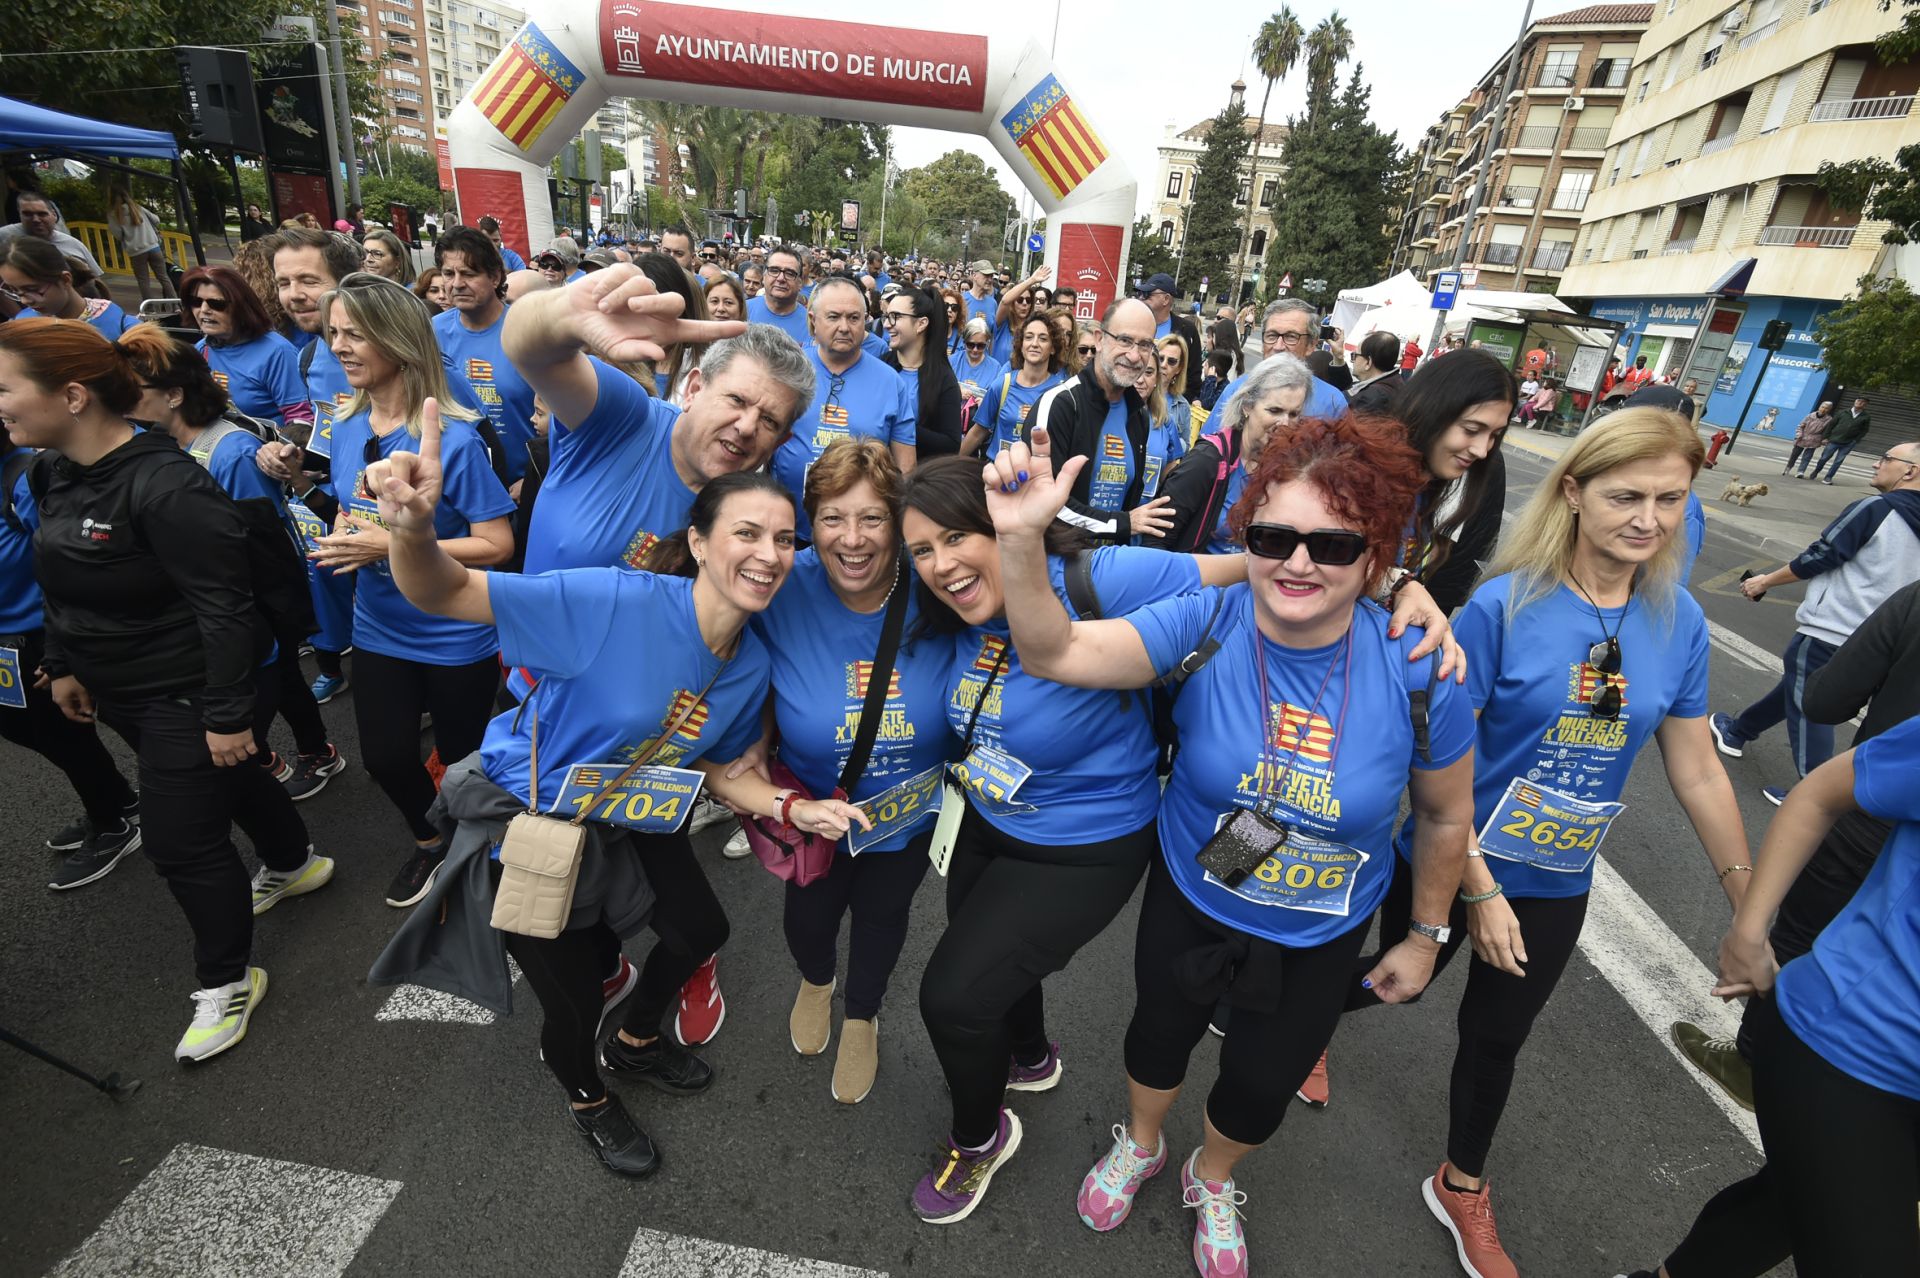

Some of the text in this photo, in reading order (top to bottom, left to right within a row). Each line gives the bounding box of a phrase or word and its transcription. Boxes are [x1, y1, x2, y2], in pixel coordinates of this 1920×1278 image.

[655, 34, 972, 86] AYUNTAMIENTO DE MURCIA
[1648, 304, 1663, 318] San
[1664, 303, 1691, 322] Roque
[835, 726, 846, 740] X
[1543, 728, 1628, 747] X VALENCIA
[652, 782, 692, 794] VALENCIA
[1236, 773, 1254, 791] X
[571, 792, 681, 821] 1704
[1500, 809, 1601, 852] 2654
[1301, 851, 1309, 860] X
[1311, 853, 1357, 863] VALENCIA
[1535, 847, 1555, 856] LOLA
[1260, 884, 1297, 896] PETALO
